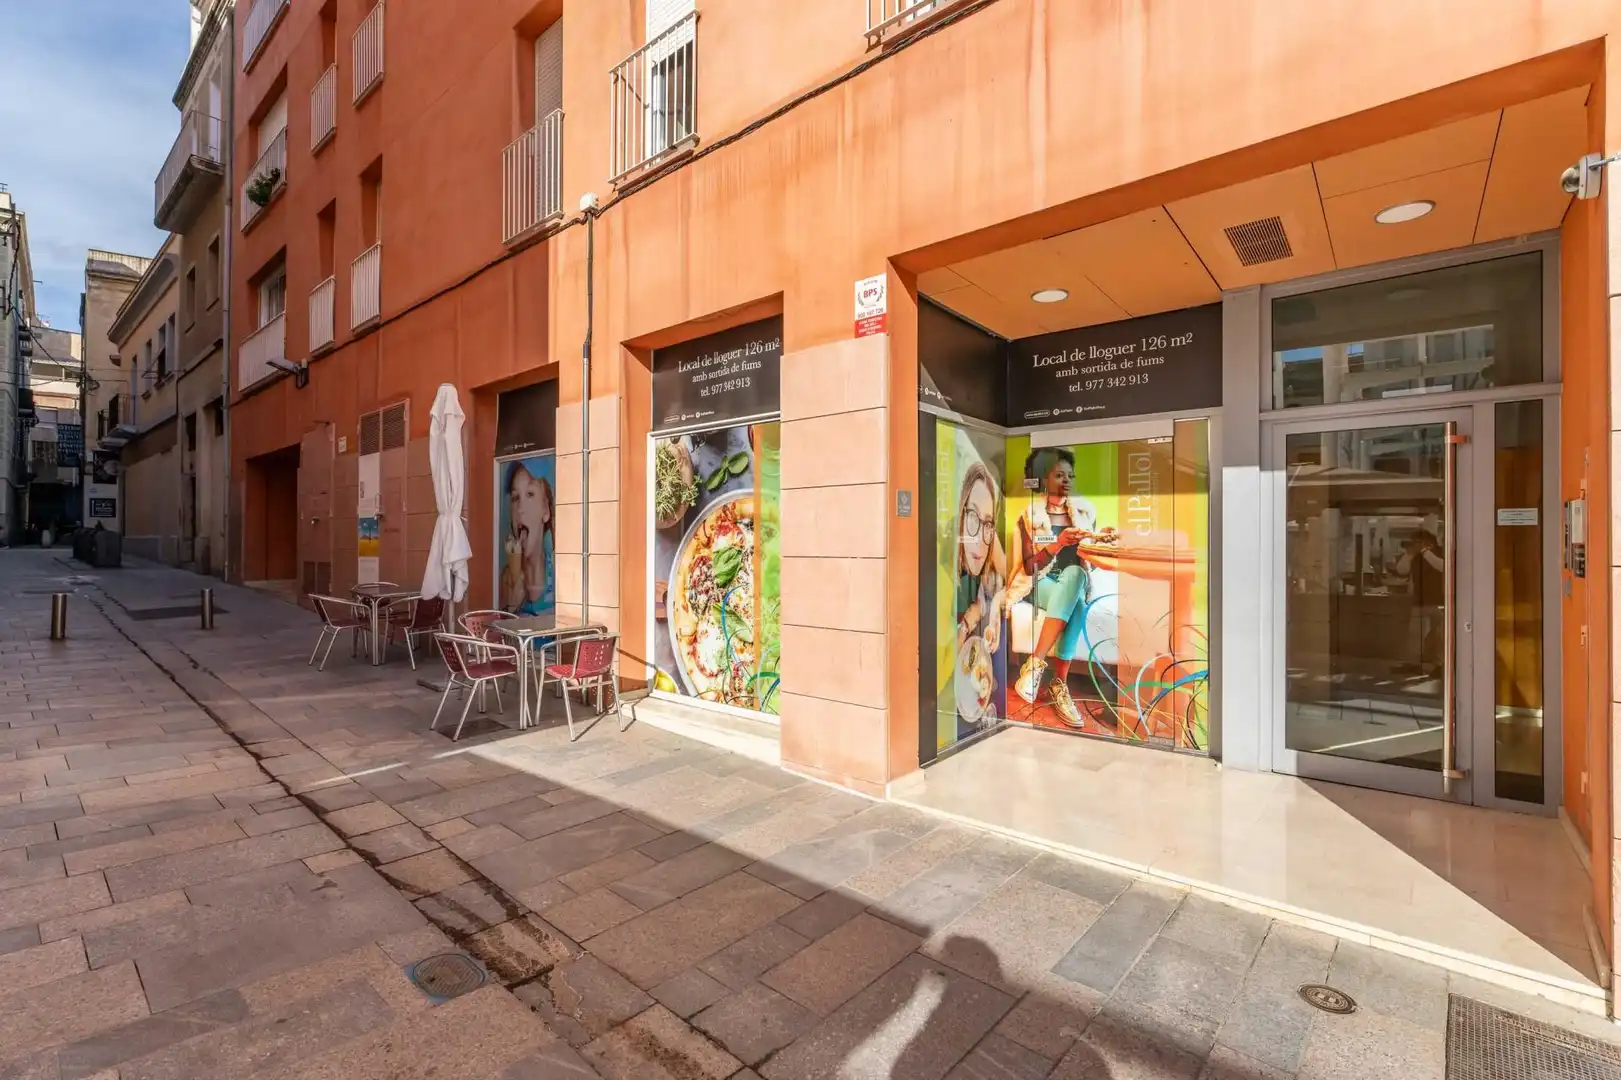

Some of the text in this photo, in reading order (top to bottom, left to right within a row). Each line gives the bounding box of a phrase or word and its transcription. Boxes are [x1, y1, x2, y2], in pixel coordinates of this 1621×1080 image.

[863, 287, 878, 299] BPS
[678, 356, 700, 373] Local
[701, 354, 713, 368] de
[713, 348, 742, 365] lloguer
[745, 340, 763, 357] 126
[1033, 350, 1067, 368] Local
[1070, 348, 1086, 362] de
[1089, 343, 1137, 361] lloguer
[1141, 335, 1167, 351] 126
[692, 360, 762, 383] amb sortida de fums
[1055, 354, 1165, 379] amb sortida de fums
[700, 377, 751, 397] tel. 977 342 913
[1069, 373, 1149, 393] tel. 977 342 913
